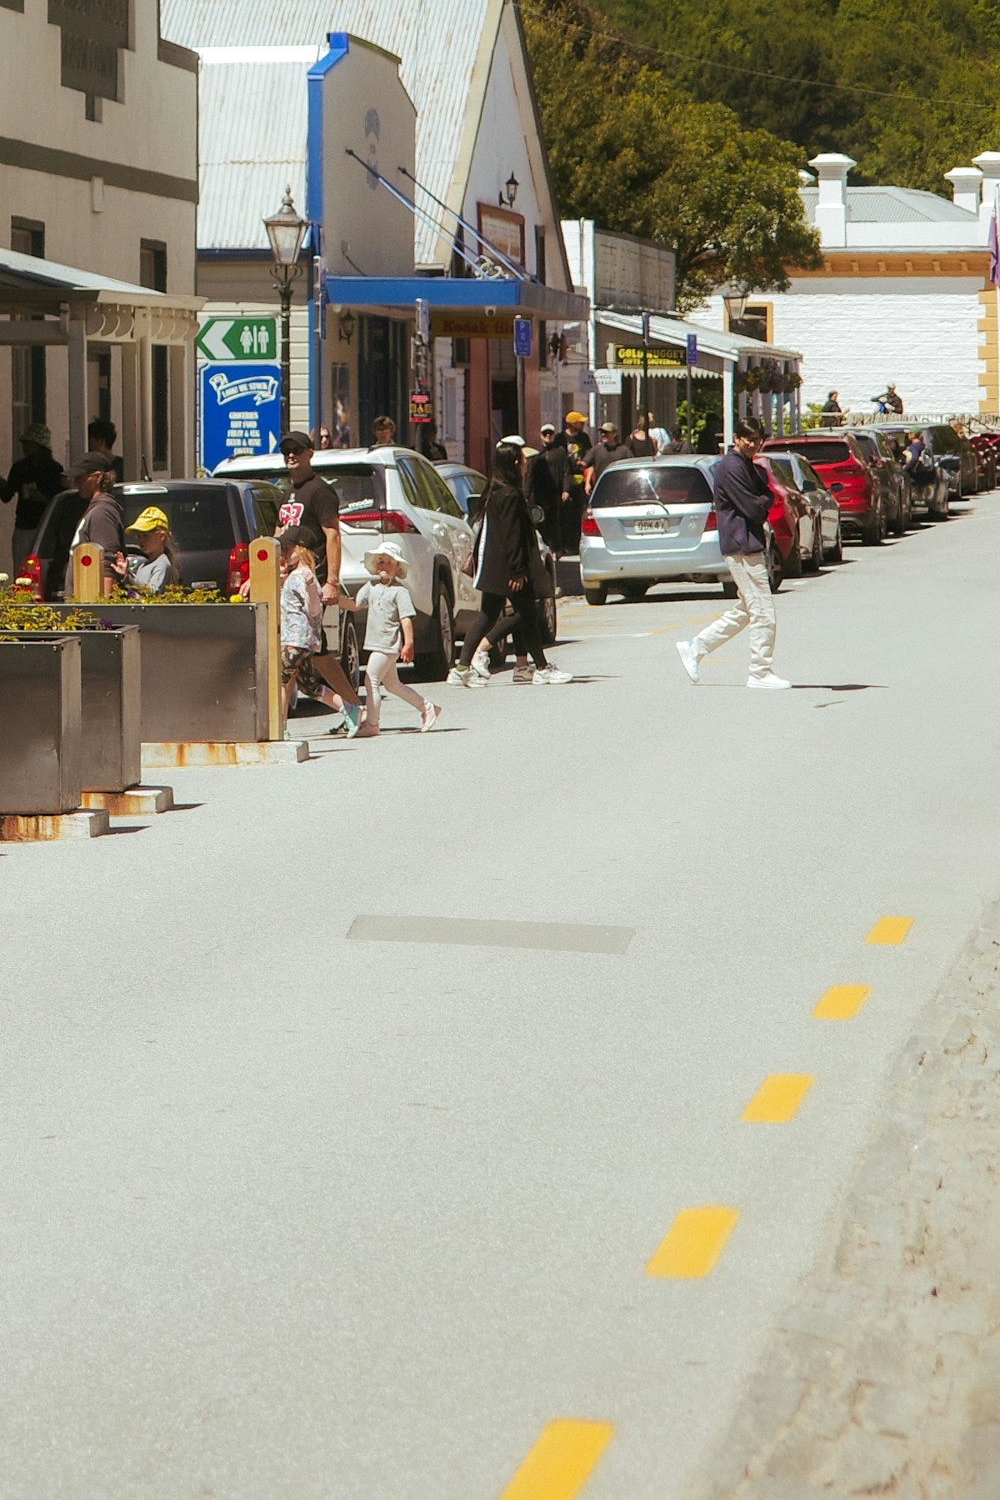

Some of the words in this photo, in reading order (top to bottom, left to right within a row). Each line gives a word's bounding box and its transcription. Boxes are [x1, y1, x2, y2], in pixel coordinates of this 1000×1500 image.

[442, 320, 489, 333] Kodak
[617, 348, 644, 359] GOLD
[248, 381, 269, 391] STOCK
